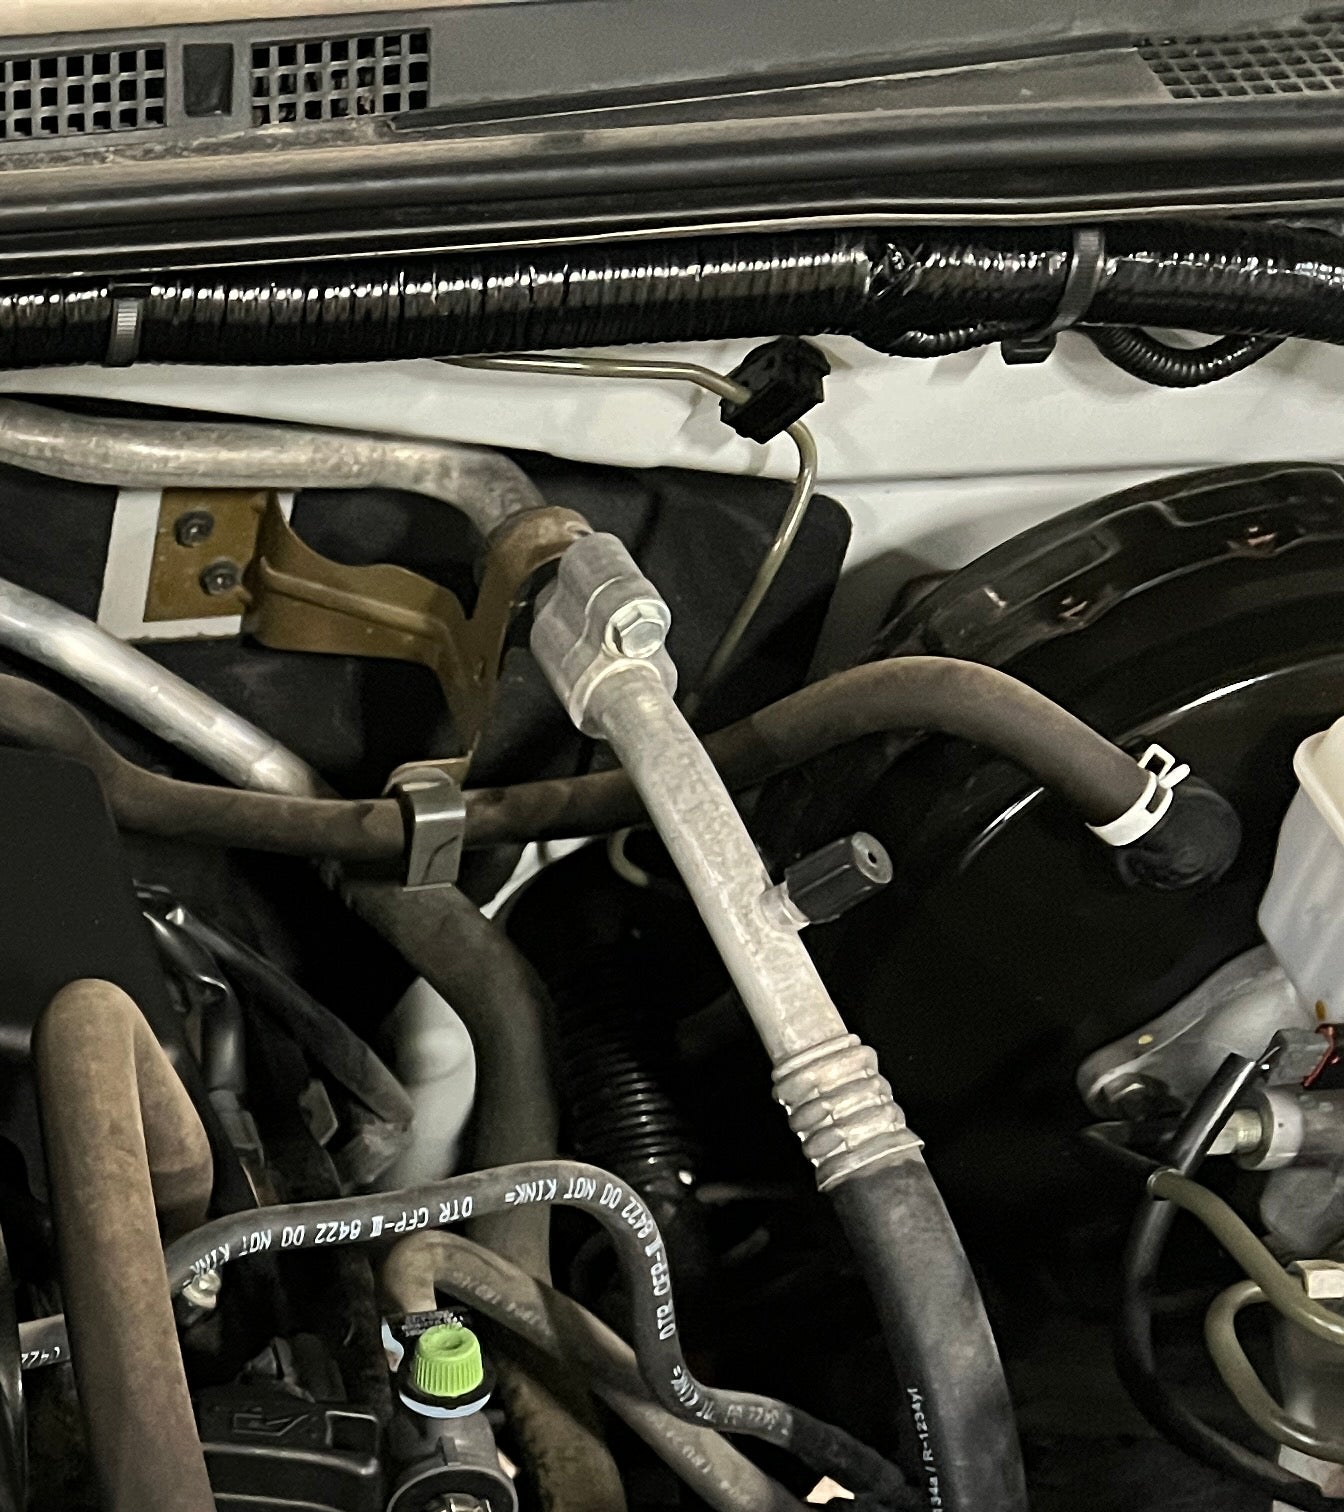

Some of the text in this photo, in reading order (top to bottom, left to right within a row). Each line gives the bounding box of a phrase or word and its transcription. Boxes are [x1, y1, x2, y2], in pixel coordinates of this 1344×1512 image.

[563, 1176, 597, 1201] NOT
[238, 1228, 273, 1257] NOT
[314, 1218, 362, 1244] 8422
